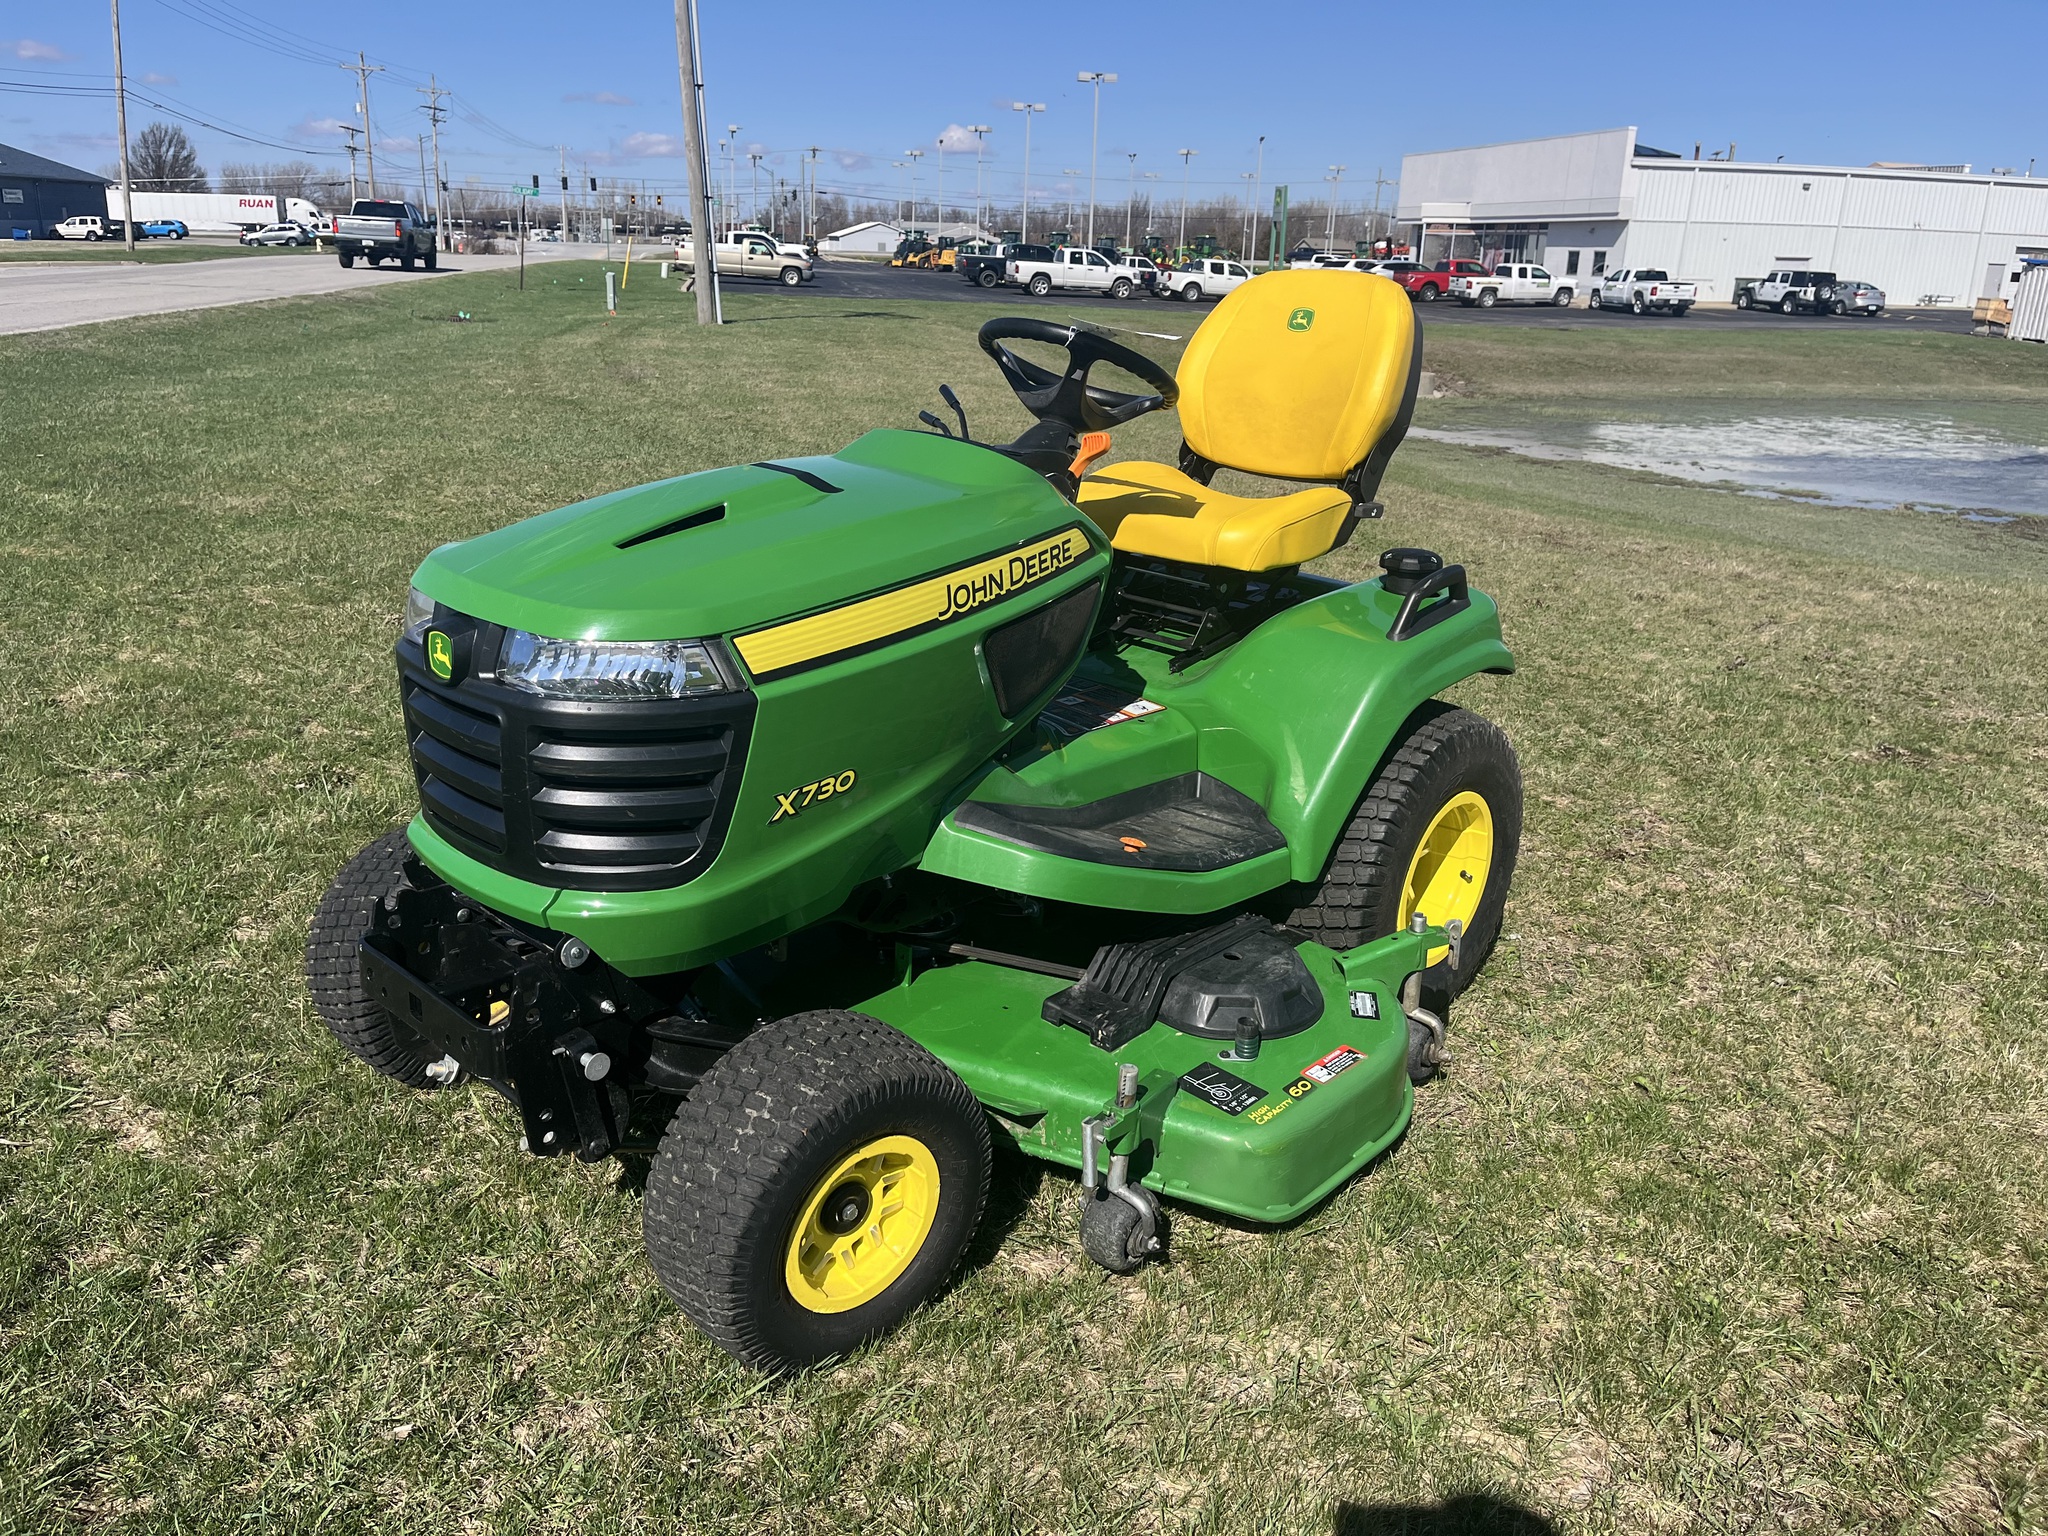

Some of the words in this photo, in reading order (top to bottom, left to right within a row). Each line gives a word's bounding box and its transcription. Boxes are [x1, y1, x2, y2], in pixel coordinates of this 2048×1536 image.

[239, 199, 273, 208] RUAN
[938, 569, 1004, 618] JOHN
[1009, 538, 1073, 588] DEERE
[770, 769, 856, 822] X730
[1289, 1080, 1312, 1097] 60
[1248, 1104, 1271, 1120] HIGH
[1256, 1098, 1293, 1125] CAPACITY
